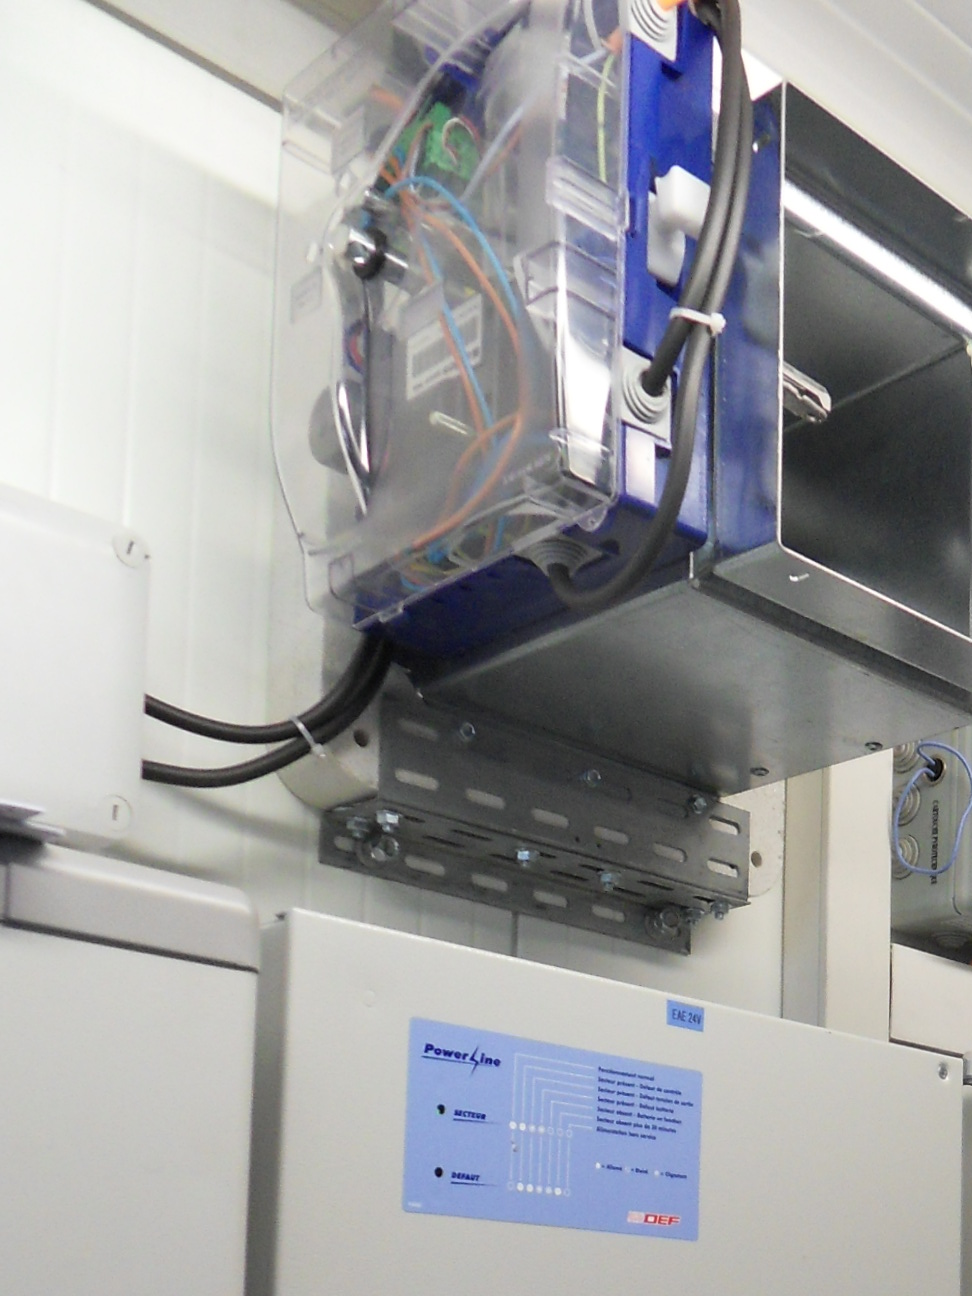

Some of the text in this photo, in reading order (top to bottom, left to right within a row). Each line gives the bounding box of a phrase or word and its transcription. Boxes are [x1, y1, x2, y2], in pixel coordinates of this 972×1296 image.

[672, 1008, 702, 1025] EAE 24V
[454, 1109, 486, 1120] SECTEUR
[644, 1213, 681, 1225] DEF
